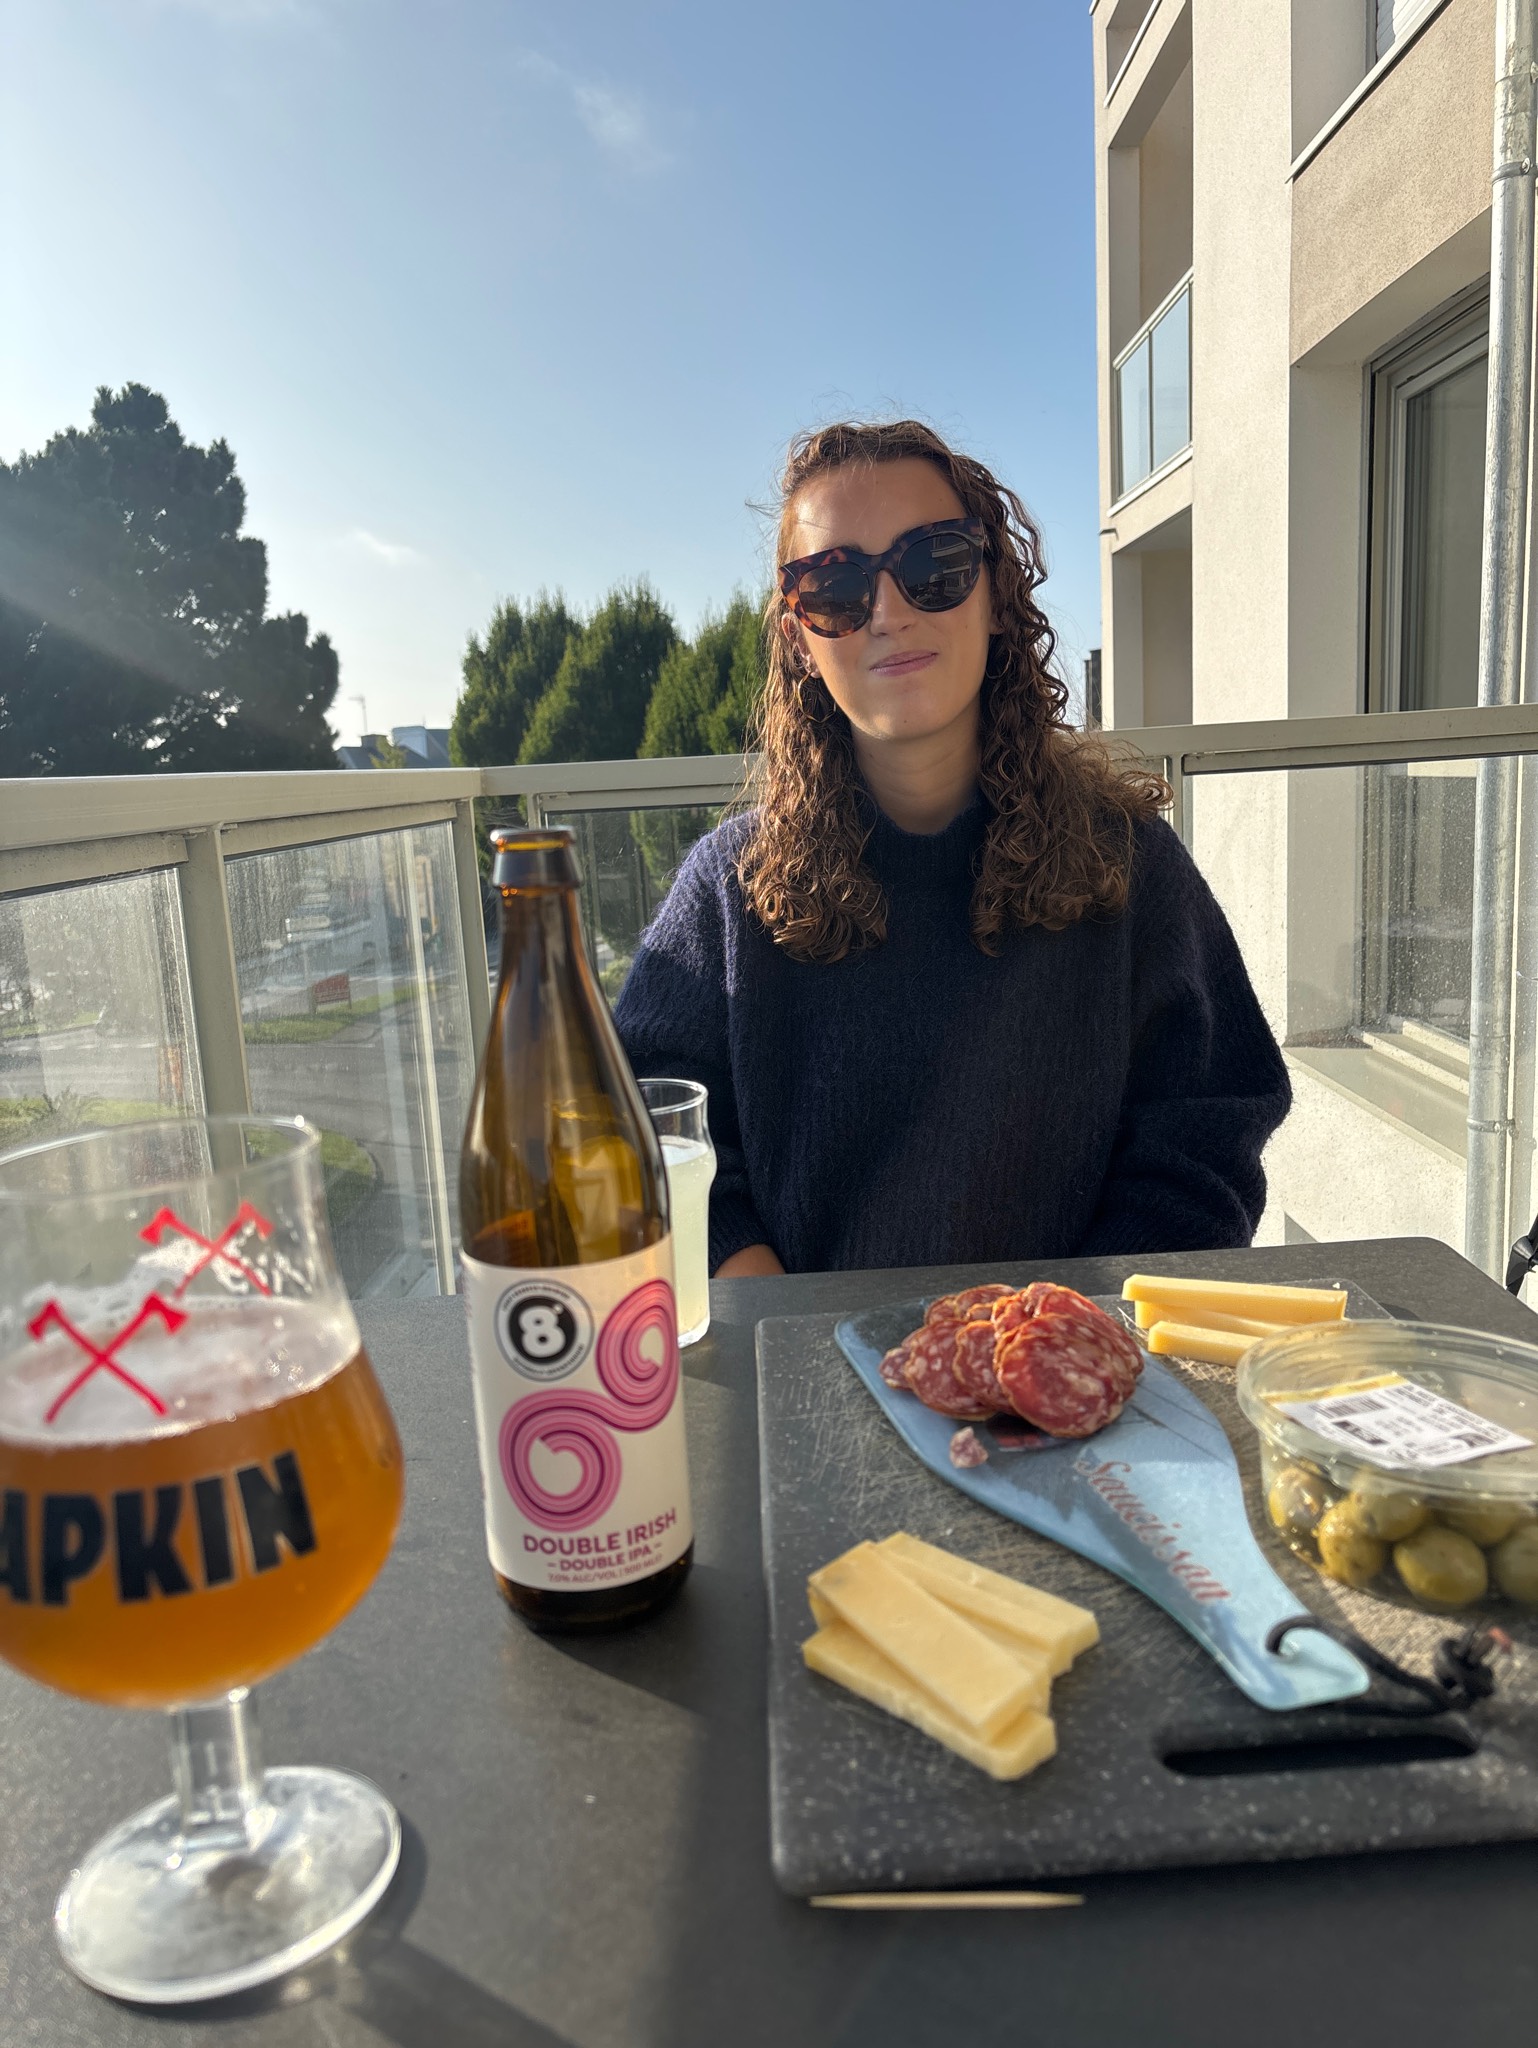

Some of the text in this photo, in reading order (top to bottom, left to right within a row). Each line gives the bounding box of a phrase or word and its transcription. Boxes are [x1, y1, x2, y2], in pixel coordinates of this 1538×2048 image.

[523, 1507, 677, 1556] DOUBLE IRISH
[1074, 1461, 1231, 1603] Saucisson
[560, 1545, 652, 1572] DOUBLE IPA
